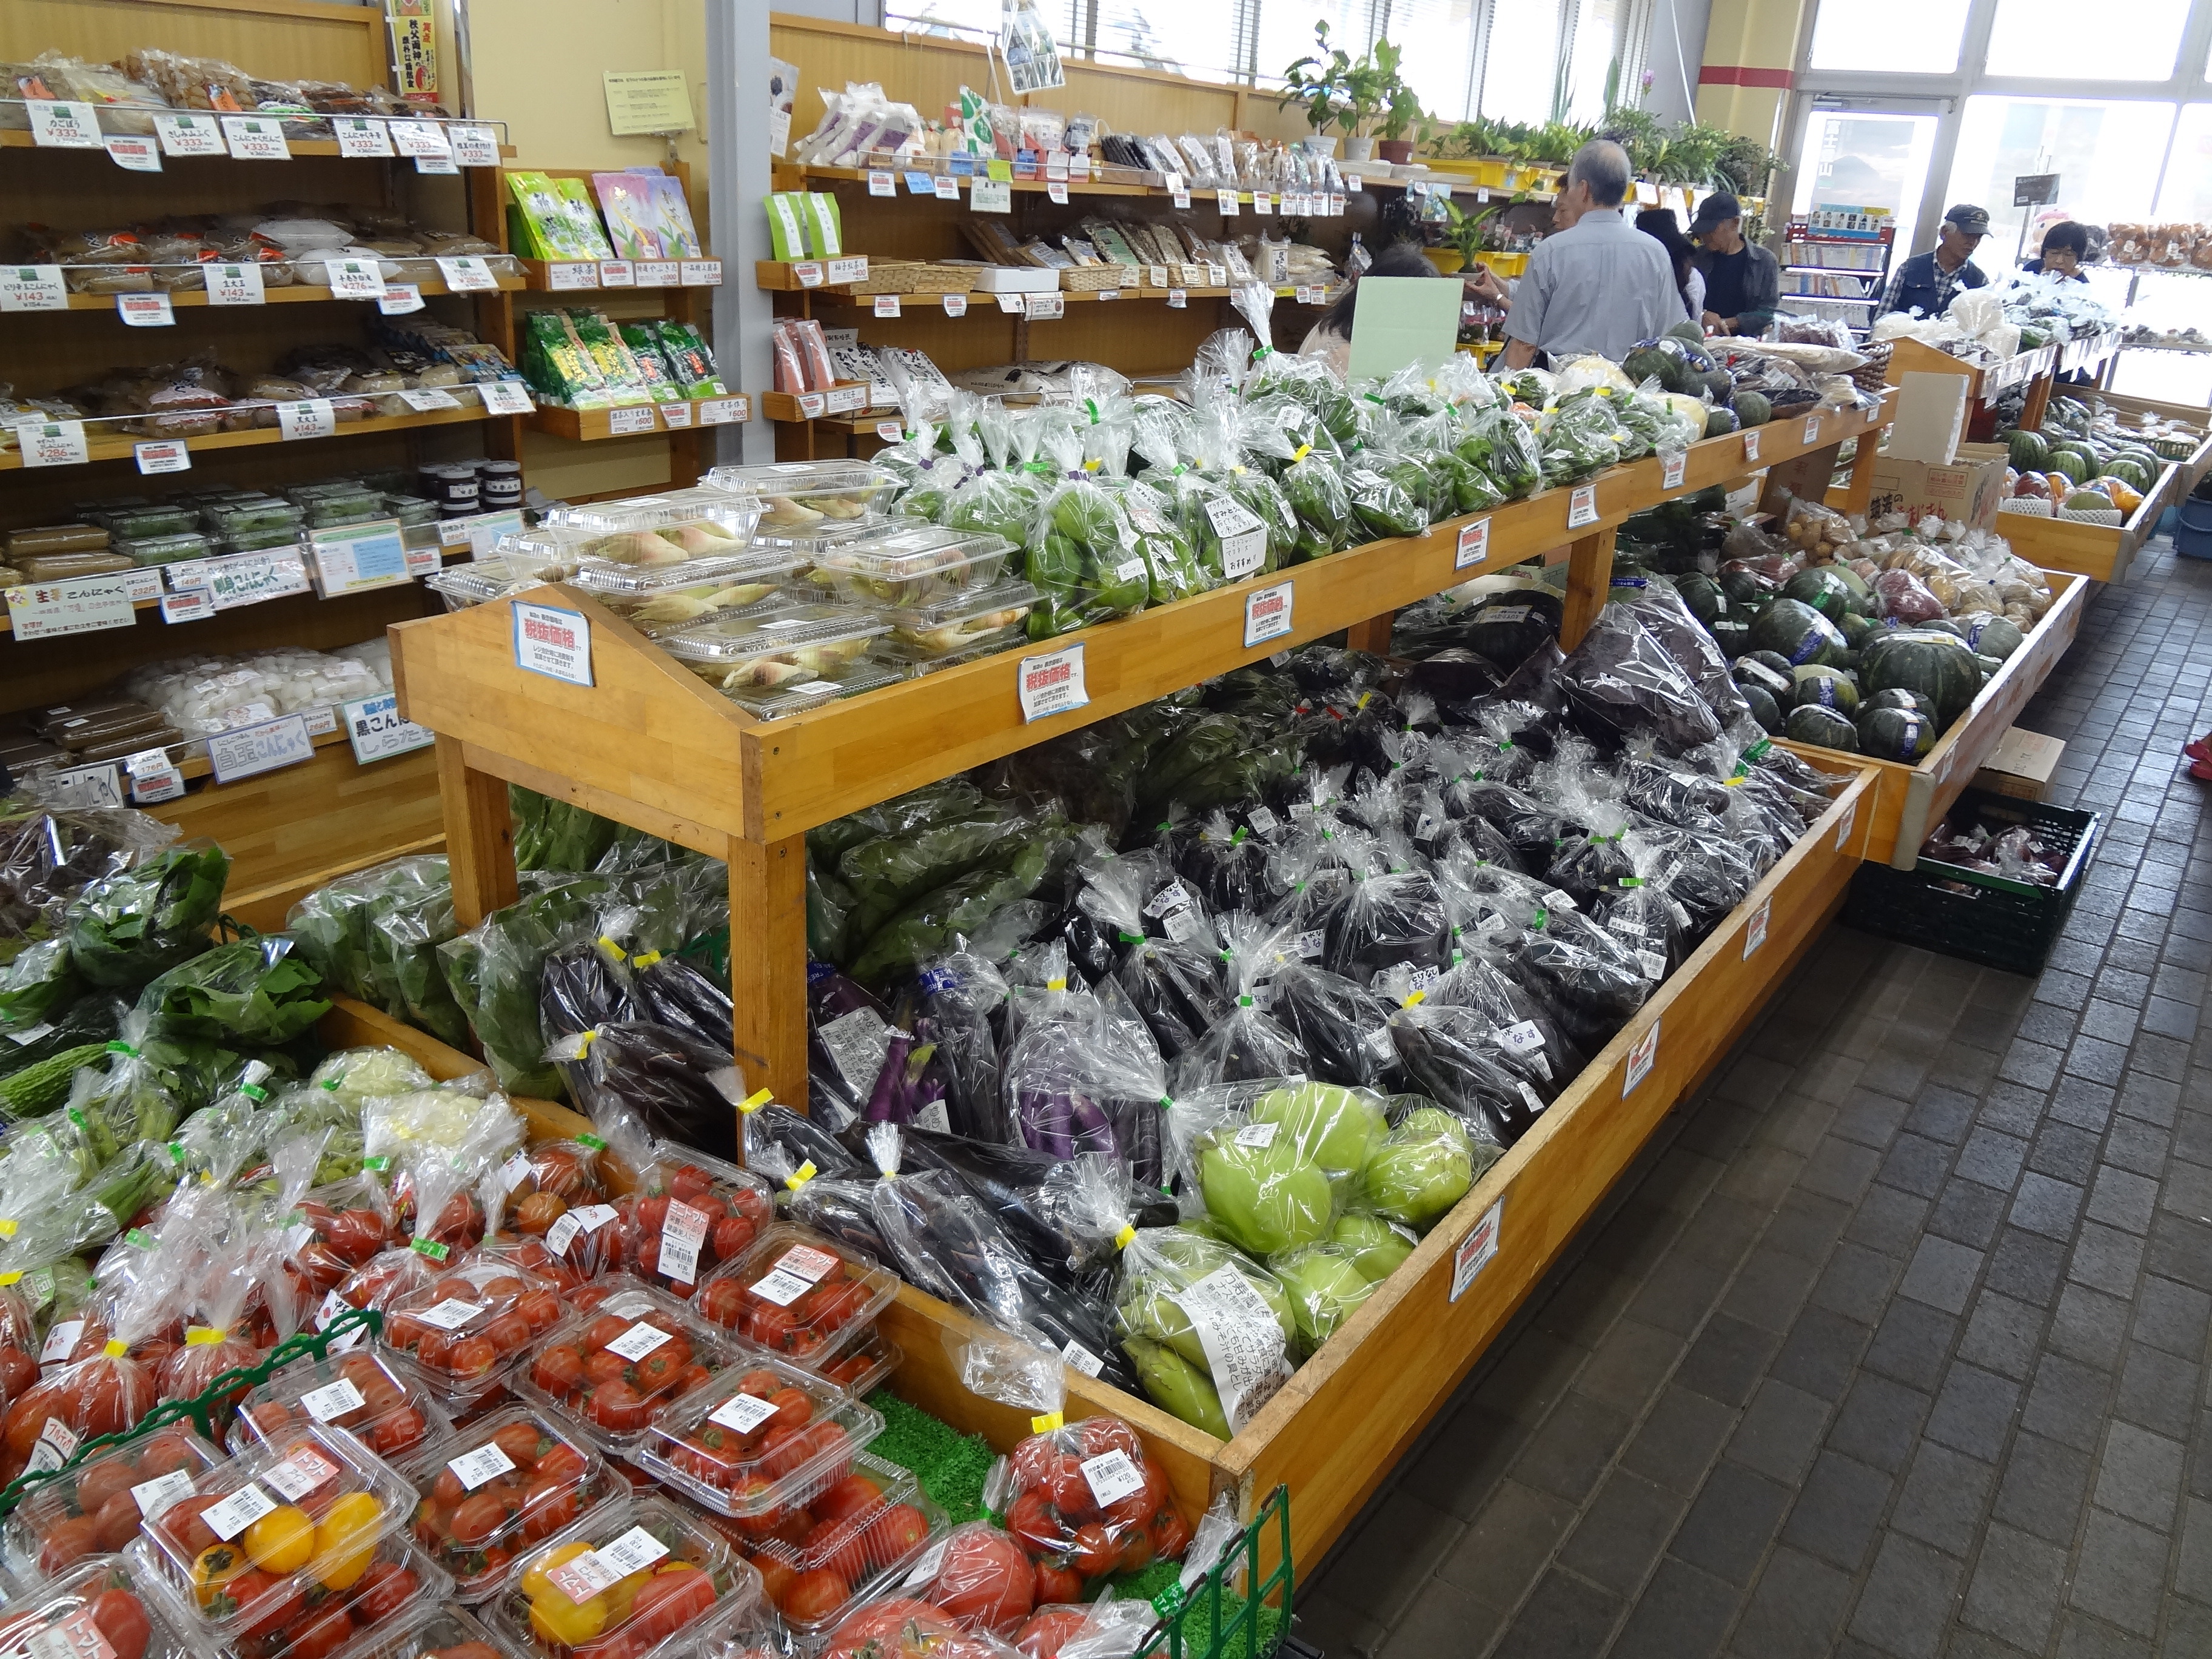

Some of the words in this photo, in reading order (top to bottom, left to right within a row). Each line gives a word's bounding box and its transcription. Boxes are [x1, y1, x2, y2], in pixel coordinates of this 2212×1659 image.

[46, 128, 78, 138] ¥333
[13, 292, 44, 301] ¥143
[292, 424, 317, 434] ¥143
[37, 449, 68, 458] ¥286
[65, 586, 124, 599] こんにゃく
[132, 585, 157, 596] 232円
[524, 617, 575, 651] 税抜価格
[1026, 662, 1071, 692] 税抜価格
[1512, 1028, 1535, 1044] なす
[670, 1200, 707, 1225] ミニトマト
[669, 1215, 703, 1235] 栄養たっぷり
[791, 1245, 833, 1266] ミニトマト
[786, 1256, 825, 1272] 栄養たっぷり
[295, 1452, 329, 1476] トマト
[1118, 1472, 1131, 1483] ¥120
[558, 1571, 591, 1598] トマト
